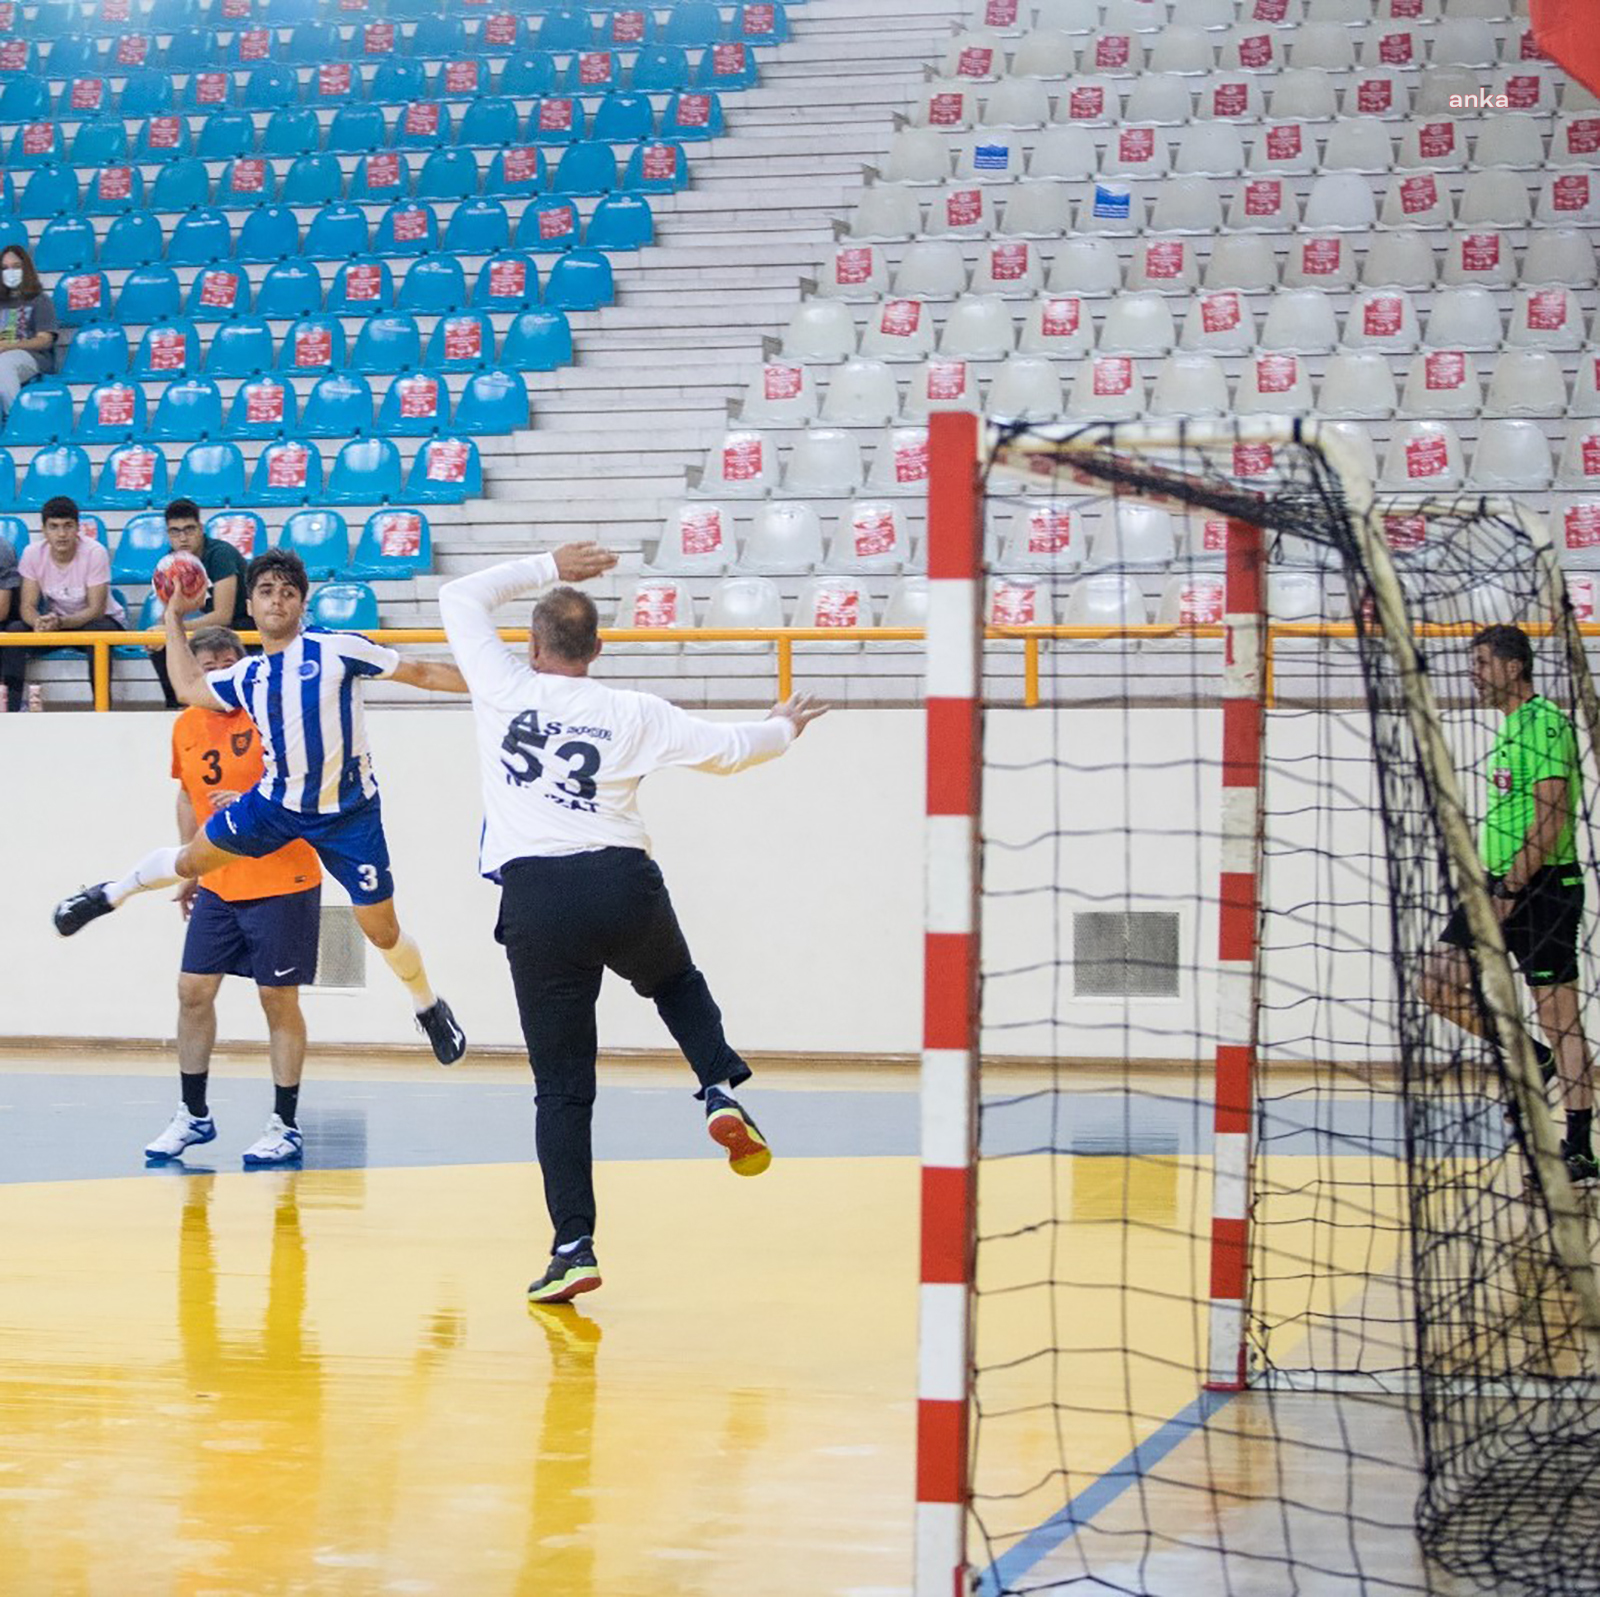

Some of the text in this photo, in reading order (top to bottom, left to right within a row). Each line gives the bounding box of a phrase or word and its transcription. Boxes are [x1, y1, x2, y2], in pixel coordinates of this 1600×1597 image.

[202, 749, 223, 786] 3
[501, 728, 601, 800] 53
[358, 863, 380, 892] 3
